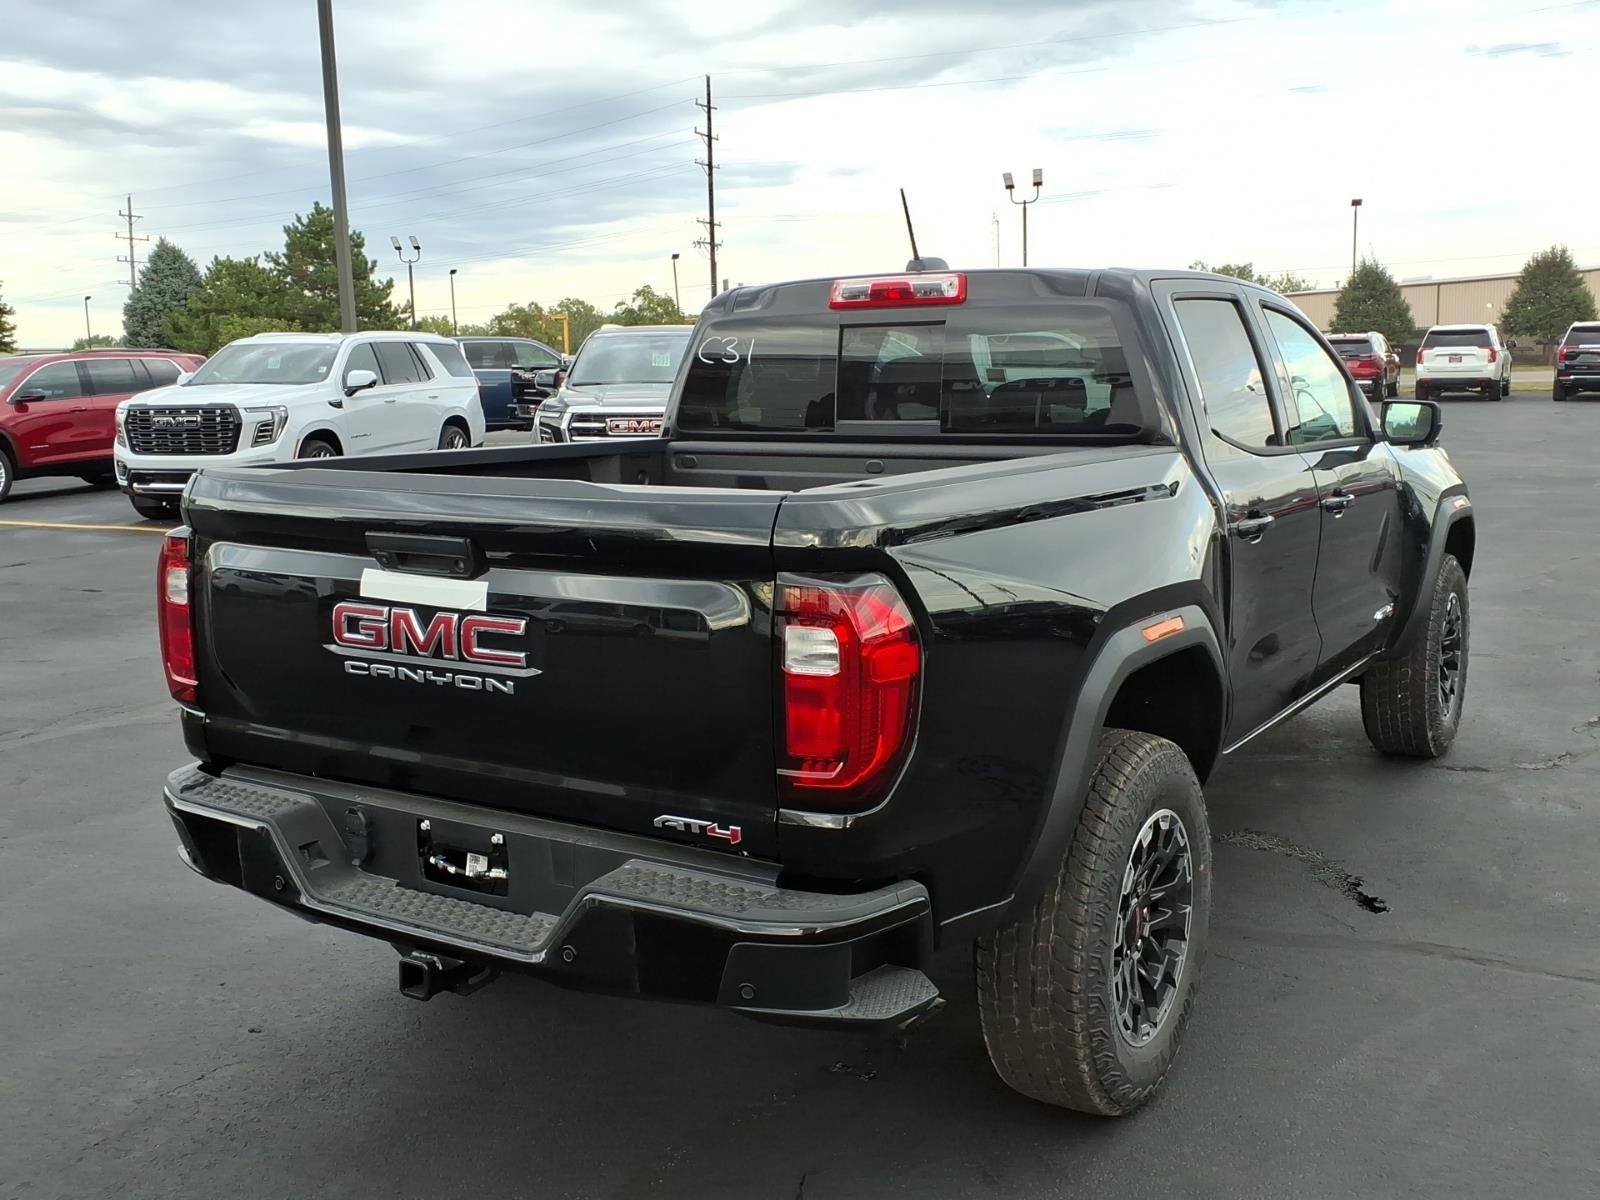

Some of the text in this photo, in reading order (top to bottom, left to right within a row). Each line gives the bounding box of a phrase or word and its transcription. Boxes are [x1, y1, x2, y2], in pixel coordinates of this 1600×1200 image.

[152, 416, 197, 428] GMC
[332, 601, 527, 669] GMC
[343, 660, 515, 696] CANYON
[653, 814, 742, 845] AT4
